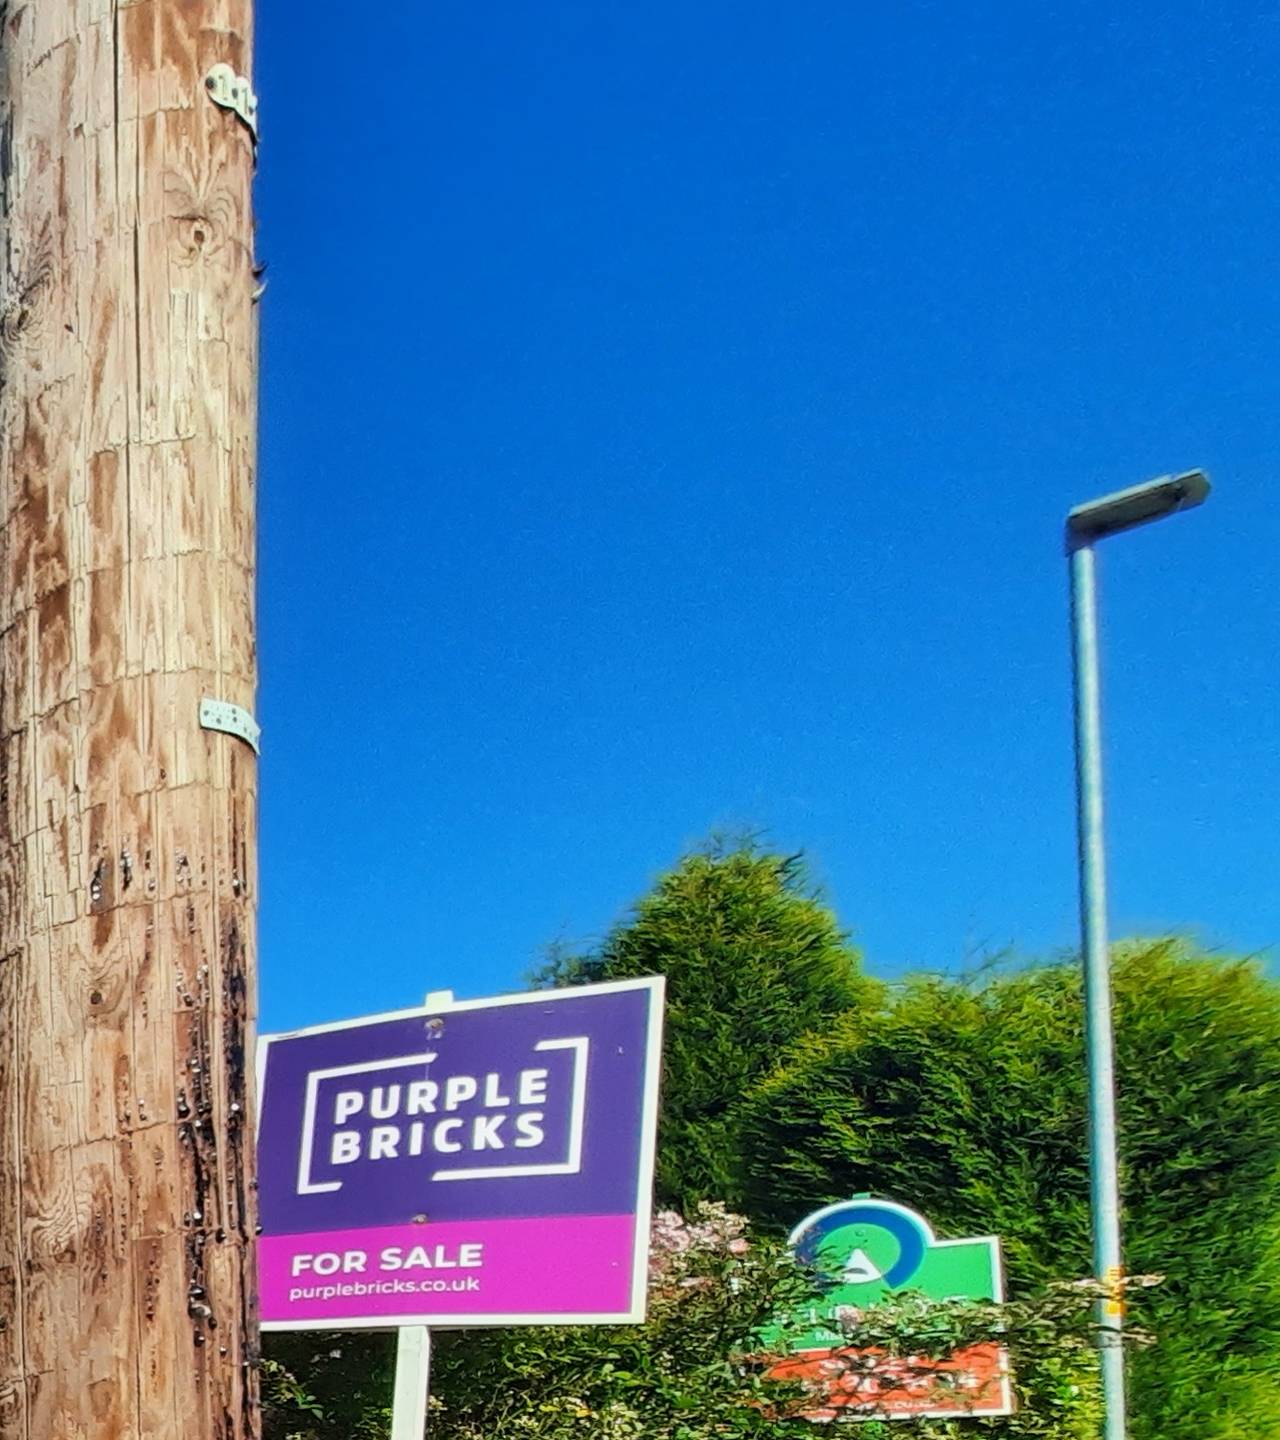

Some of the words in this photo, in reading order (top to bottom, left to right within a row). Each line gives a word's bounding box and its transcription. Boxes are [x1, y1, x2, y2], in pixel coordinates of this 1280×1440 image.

[334, 1067, 549, 1125] PURPLE
[330, 1112, 545, 1165] BRICKS
[292, 1250, 367, 1277] FOR
[380, 1243, 484, 1271] SALE
[290, 1276, 480, 1302] purplebricks.co.uk
